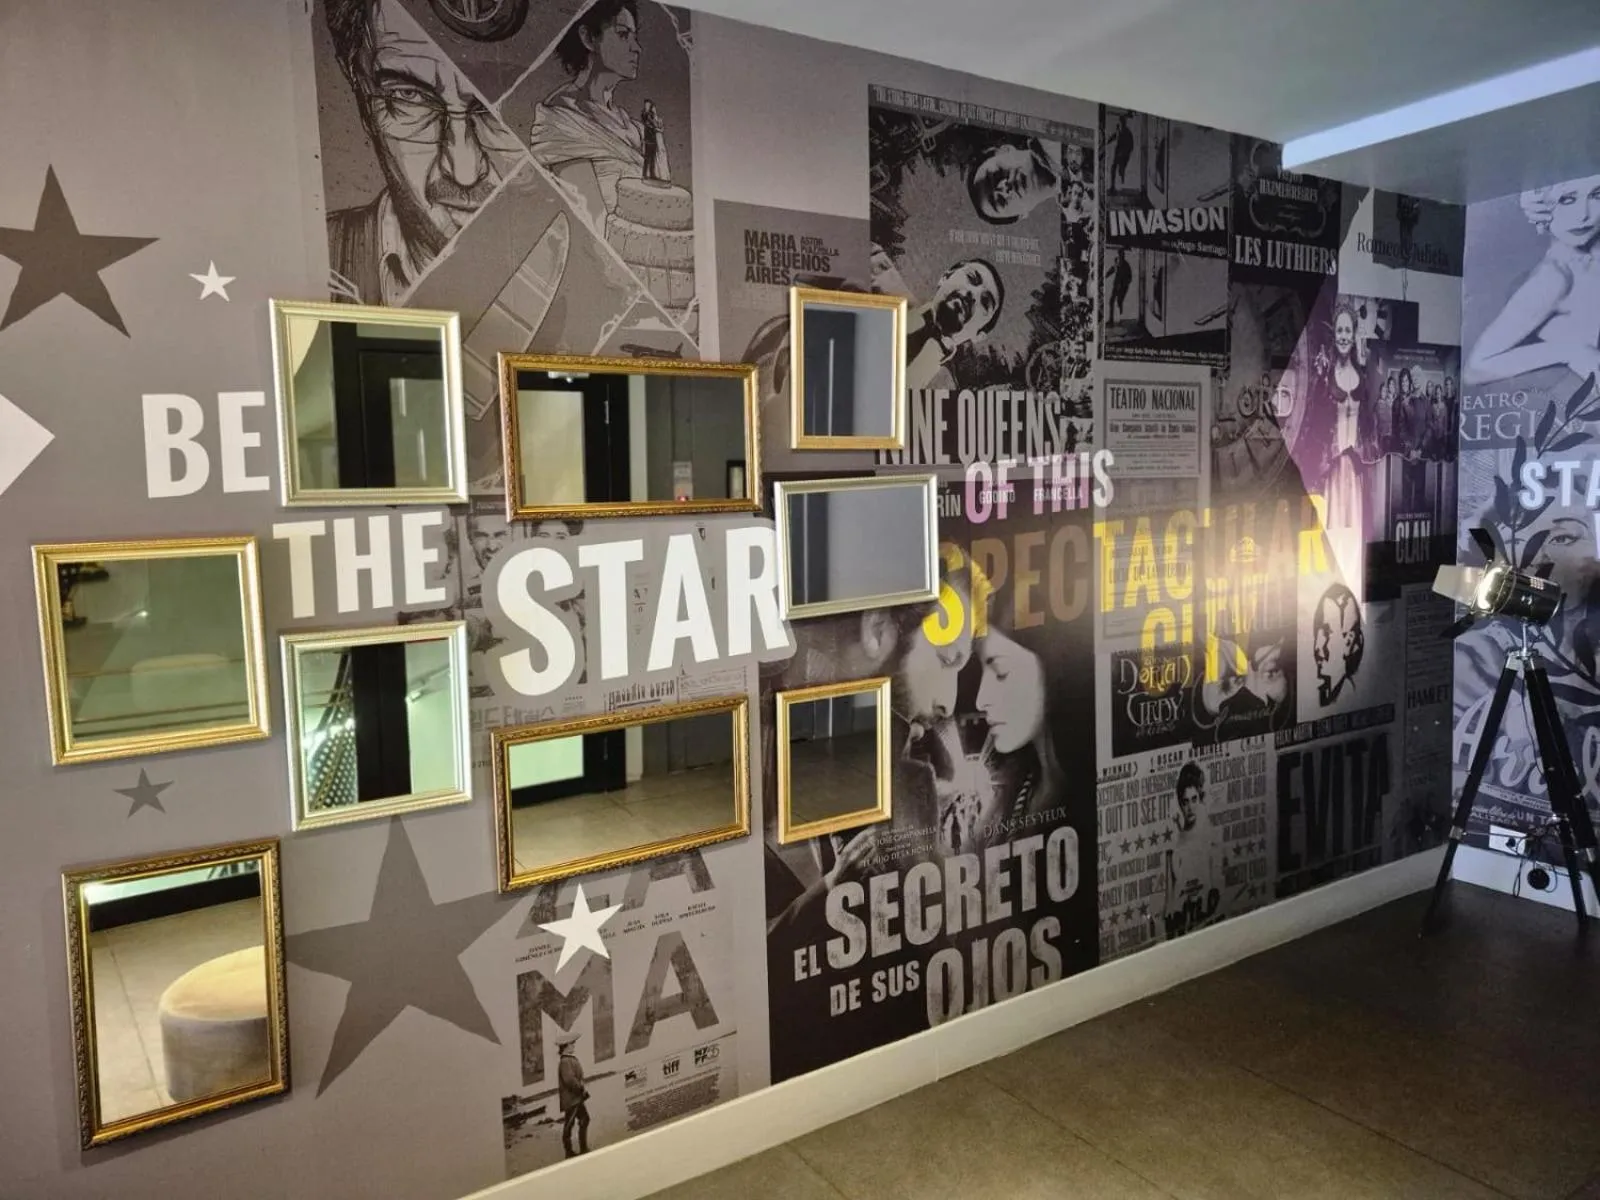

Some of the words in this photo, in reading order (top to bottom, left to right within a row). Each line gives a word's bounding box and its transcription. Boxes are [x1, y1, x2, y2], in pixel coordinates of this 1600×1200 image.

[744, 229, 797, 252] MARIA
[1109, 206, 1226, 237] INVASION
[745, 248, 767, 266] DE
[771, 250, 832, 273] BUENOS
[1235, 234, 1261, 266] LES
[1266, 239, 1337, 276] LUTHIERS
[745, 266, 791, 286] AIRES
[1110, 387, 1147, 410] TEATRO
[1152, 388, 1196, 411] NACIONAL
[1461, 392, 1528, 411] EATRO
[142, 391, 270, 498] BE
[879, 388, 950, 465] INE
[957, 388, 1062, 468] QUEENS
[937, 488, 962, 517] RÍN
[964, 458, 1018, 524] OF
[1027, 449, 1115, 516] THIS
[1395, 519, 1432, 565] CLAN
[273, 511, 446, 619] THE
[497, 526, 791, 697] STAR
[1157, 750, 1184, 766] OSCAR
[1038, 805, 1068, 825] YEUX
[1106, 804, 1124, 834] OUT
[1125, 801, 1138, 829] TO
[1140, 795, 1157, 826] SEE
[1277, 732, 1390, 873] EVITA
[825, 826, 1080, 971] SECRETO
[794, 944, 822, 982] EL
[925, 916, 1063, 1028] OJOS
[829, 978, 863, 1017] DE
[871, 960, 920, 1004] SUS
[662, 1059, 681, 1075] tiff
